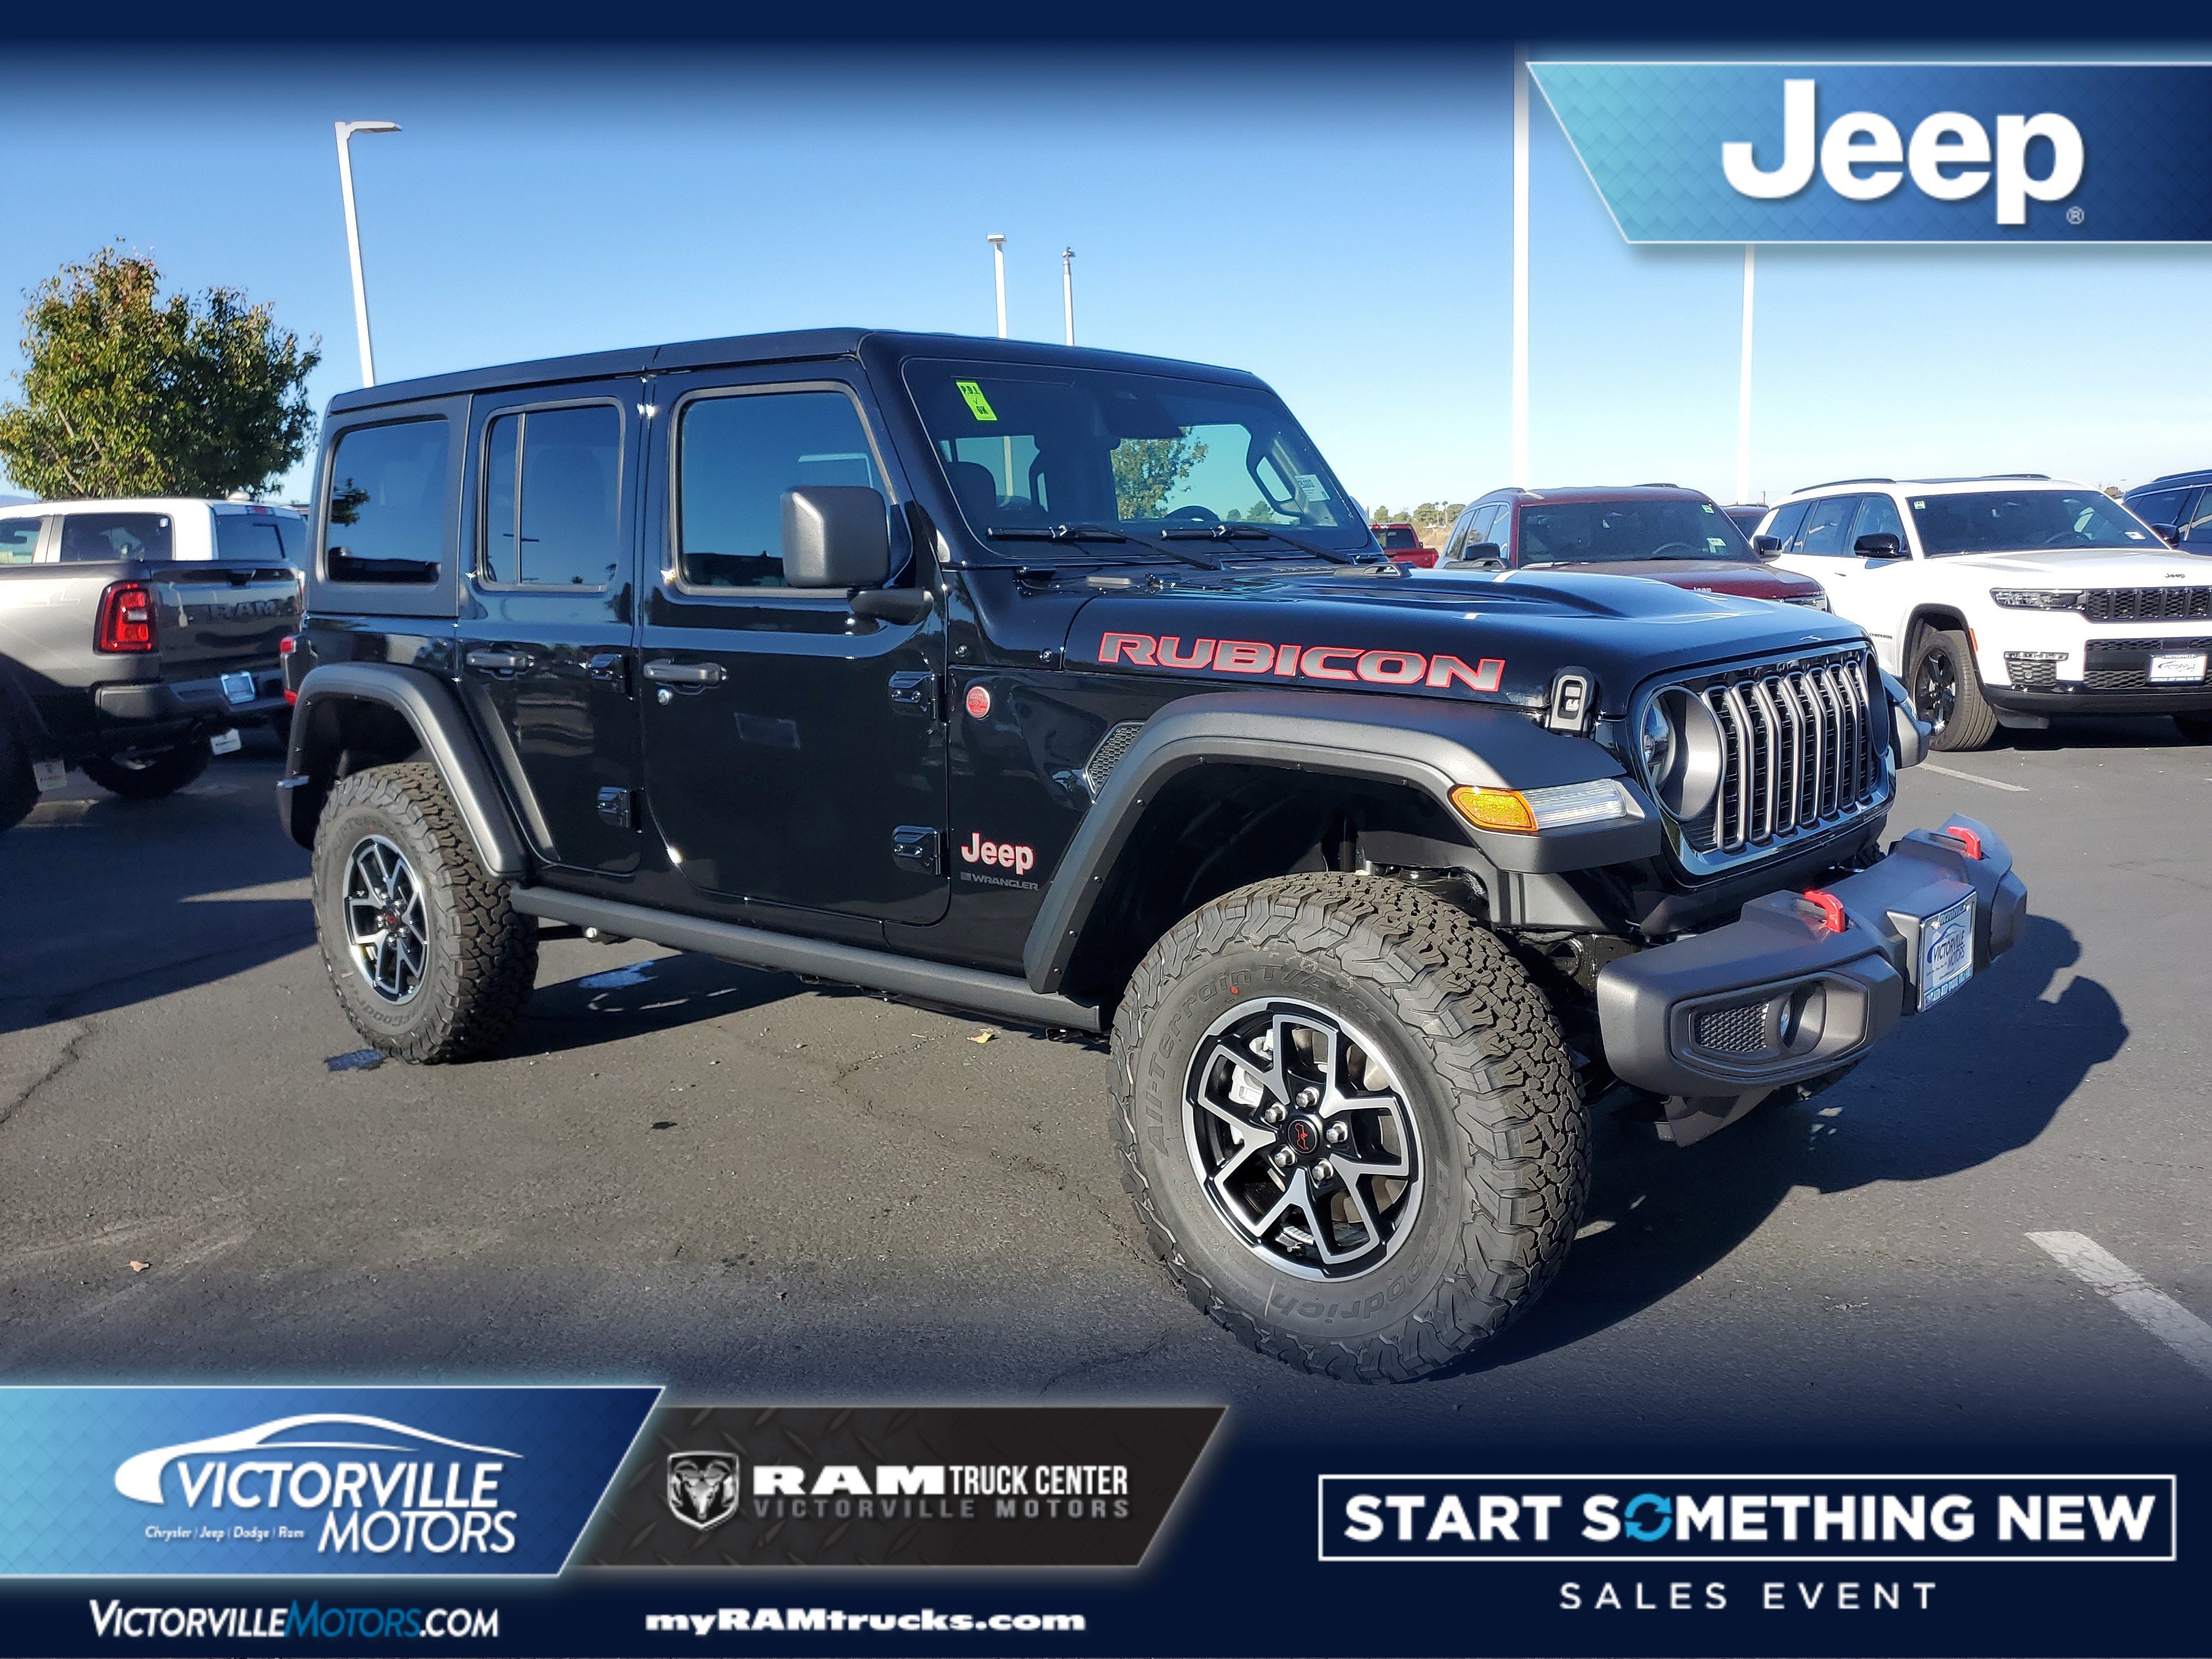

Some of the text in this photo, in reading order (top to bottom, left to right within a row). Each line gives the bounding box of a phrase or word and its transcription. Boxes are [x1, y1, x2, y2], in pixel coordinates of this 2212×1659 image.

[1097, 632, 1505, 692] RUBICON
[961, 832, 1034, 876] Jeep
[972, 873, 1039, 891] WRANGLER
[1933, 929, 1965, 963] VICTORVILLE
